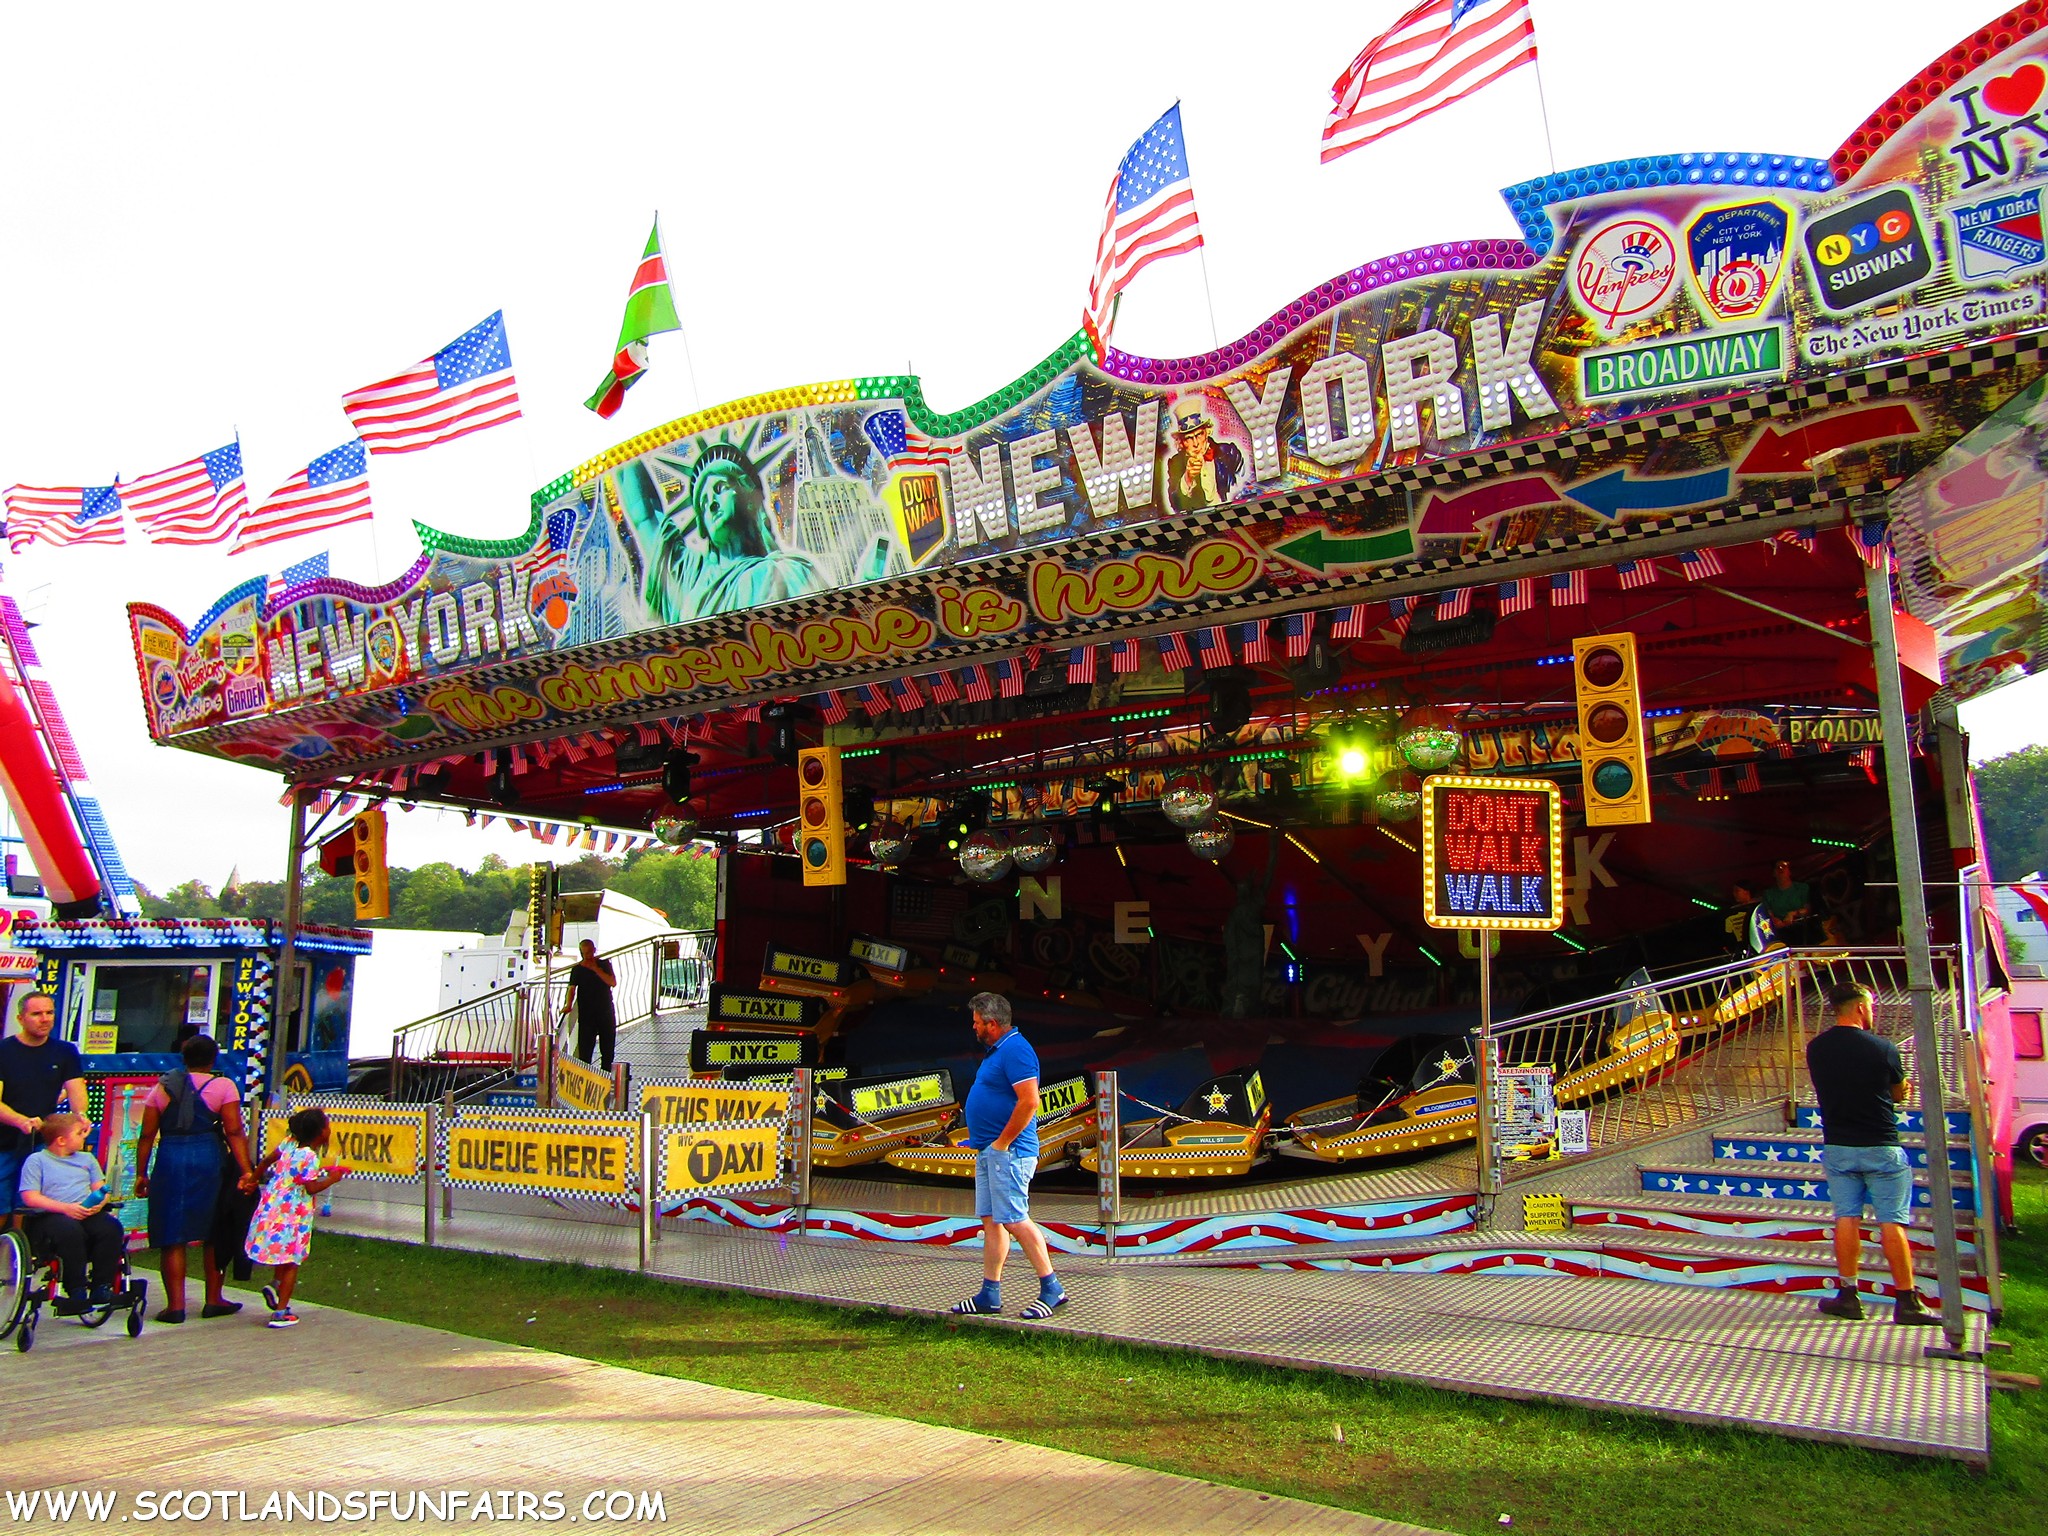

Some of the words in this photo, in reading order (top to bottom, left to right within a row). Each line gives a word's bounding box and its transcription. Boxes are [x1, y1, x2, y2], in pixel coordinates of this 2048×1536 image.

[1950, 85, 1992, 137] I
[1695, 223, 1715, 243] FIRE
[1717, 209, 1781, 230] DEPARTMENT
[1718, 226, 1740, 236] CITY
[1743, 223, 1757, 232] OF
[1960, 206, 1994, 228] NEW
[1996, 197, 2038, 219] YORK
[1712, 236, 1735, 245] NEW
[1738, 230, 1762, 240] YORK
[1824, 216, 1902, 261] NYC
[1973, 228, 2041, 260] RANGERS
[1579, 262, 1676, 304] Yankees
[1829, 243, 1915, 291] SUBWAY
[1808, 334, 1849, 358] The
[1852, 324, 1899, 349] New
[1902, 307, 1960, 340] York
[1962, 292, 2034, 322] Times
[1597, 333, 1767, 392] BROADWAY
[950, 403, 1160, 548] NEW
[1225, 298, 1560, 482] YORK
[902, 478, 935, 506] DONT
[905, 498, 940, 533] WALK
[269, 613, 365, 702] NEW
[392, 568, 539, 672] YORK
[428, 686, 543, 731] The
[542, 607, 933, 711] atmosphere
[939, 585, 1021, 638] is
[1031, 541, 1258, 622] here
[227, 682, 266, 713] GARDEN
[1447, 793, 1540, 833] DONT
[1444, 834, 1543, 873] WALK
[1444, 873, 1545, 912] WALK
[788, 958, 822, 976] NYC
[861, 944, 891, 961] TAXI
[42, 959, 60, 995] NEW
[236, 957, 254, 993] NEW
[233, 1000, 250, 1051] YORK
[738, 1000, 785, 1018] TAXI
[730, 1045, 778, 1060] NYC
[566, 1070, 584, 1100] THIS
[584, 1079, 605, 1111] WAY
[875, 1083, 922, 1109] NYC
[1040, 1085, 1076, 1113] TAXI
[1099, 1076, 1114, 1133] NEW
[1212, 1097, 1223, 1106] 15
[1424, 1098, 1473, 1113] BLOOMINGDALE'S
[664, 1096, 709, 1122] THIS
[715, 1099, 762, 1121] WAY
[336, 1131, 394, 1164] YORK
[678, 1135, 694, 1148] NYC
[458, 1138, 539, 1175] QUEUE
[546, 1143, 616, 1181] HERE
[694, 1141, 765, 1179] TAXI
[1099, 1141, 1114, 1213] YORK
[1529, 1218, 1548, 1226] WHEN
[1548, 1218, 1561, 1226] WET
